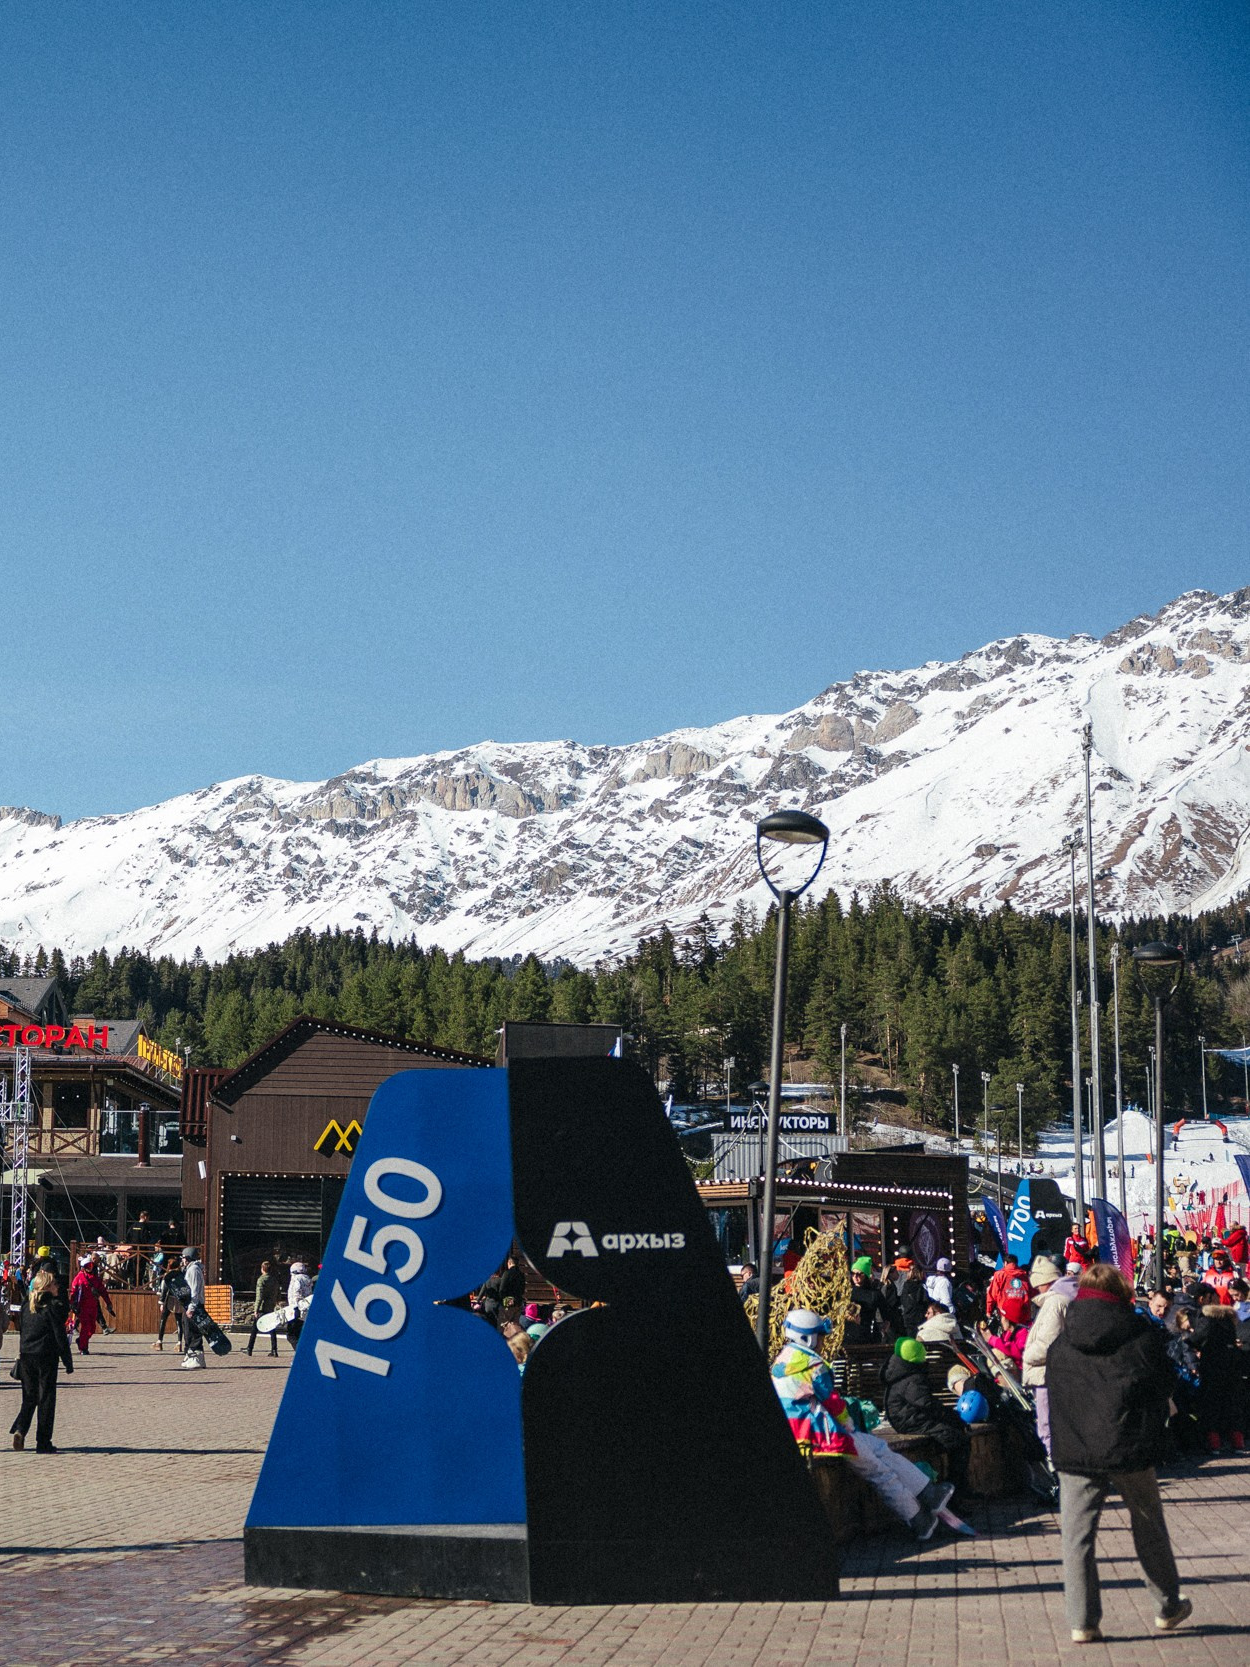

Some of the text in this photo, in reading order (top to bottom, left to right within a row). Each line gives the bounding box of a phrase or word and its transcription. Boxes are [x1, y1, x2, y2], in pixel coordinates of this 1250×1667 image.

[1007, 1195, 1031, 1242] 1700
[602, 1233, 686, 1254] архыз
[314, 1157, 443, 1379] 1650
